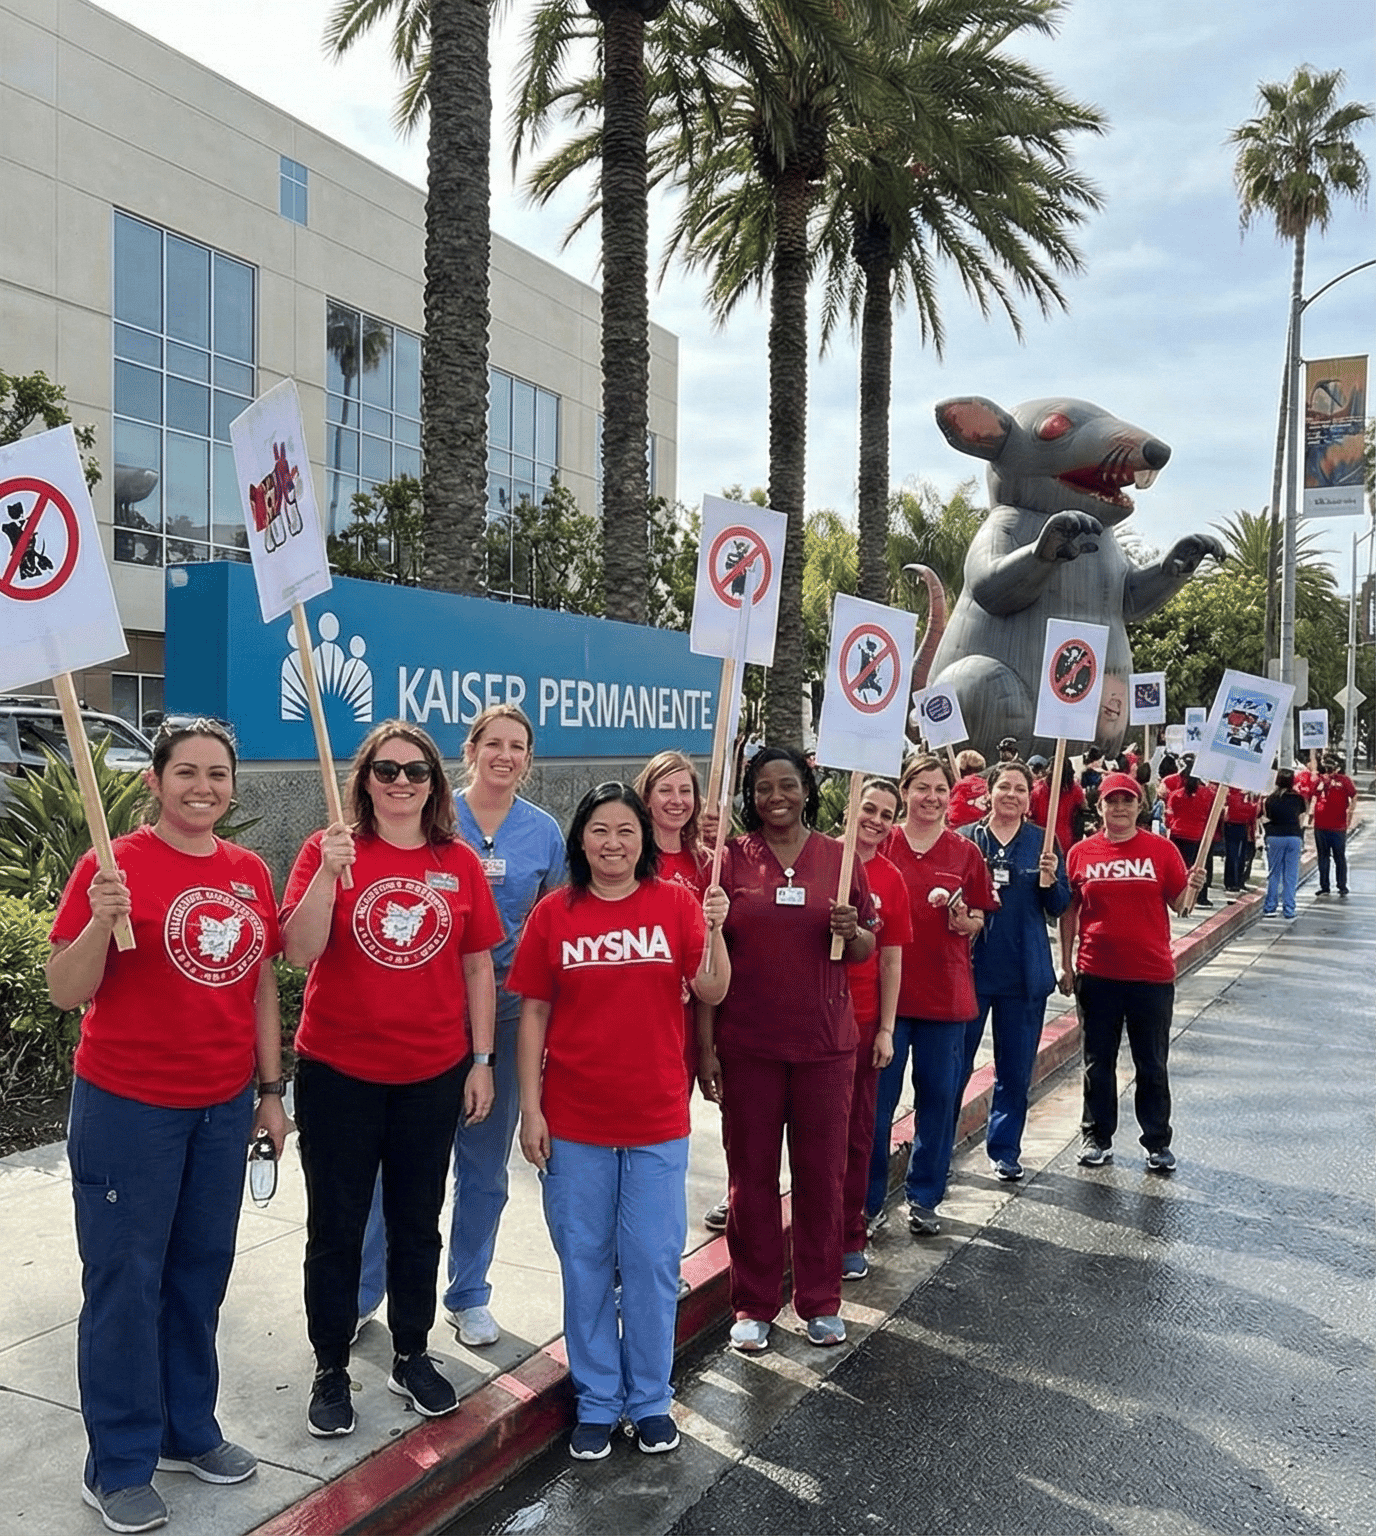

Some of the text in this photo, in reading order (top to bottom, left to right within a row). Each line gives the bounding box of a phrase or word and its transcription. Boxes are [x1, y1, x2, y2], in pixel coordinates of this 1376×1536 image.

[399, 666, 713, 730] KAISER PERMANENTE
[1085, 857, 1157, 878] NYSNA
[562, 925, 672, 965] NYSNA
